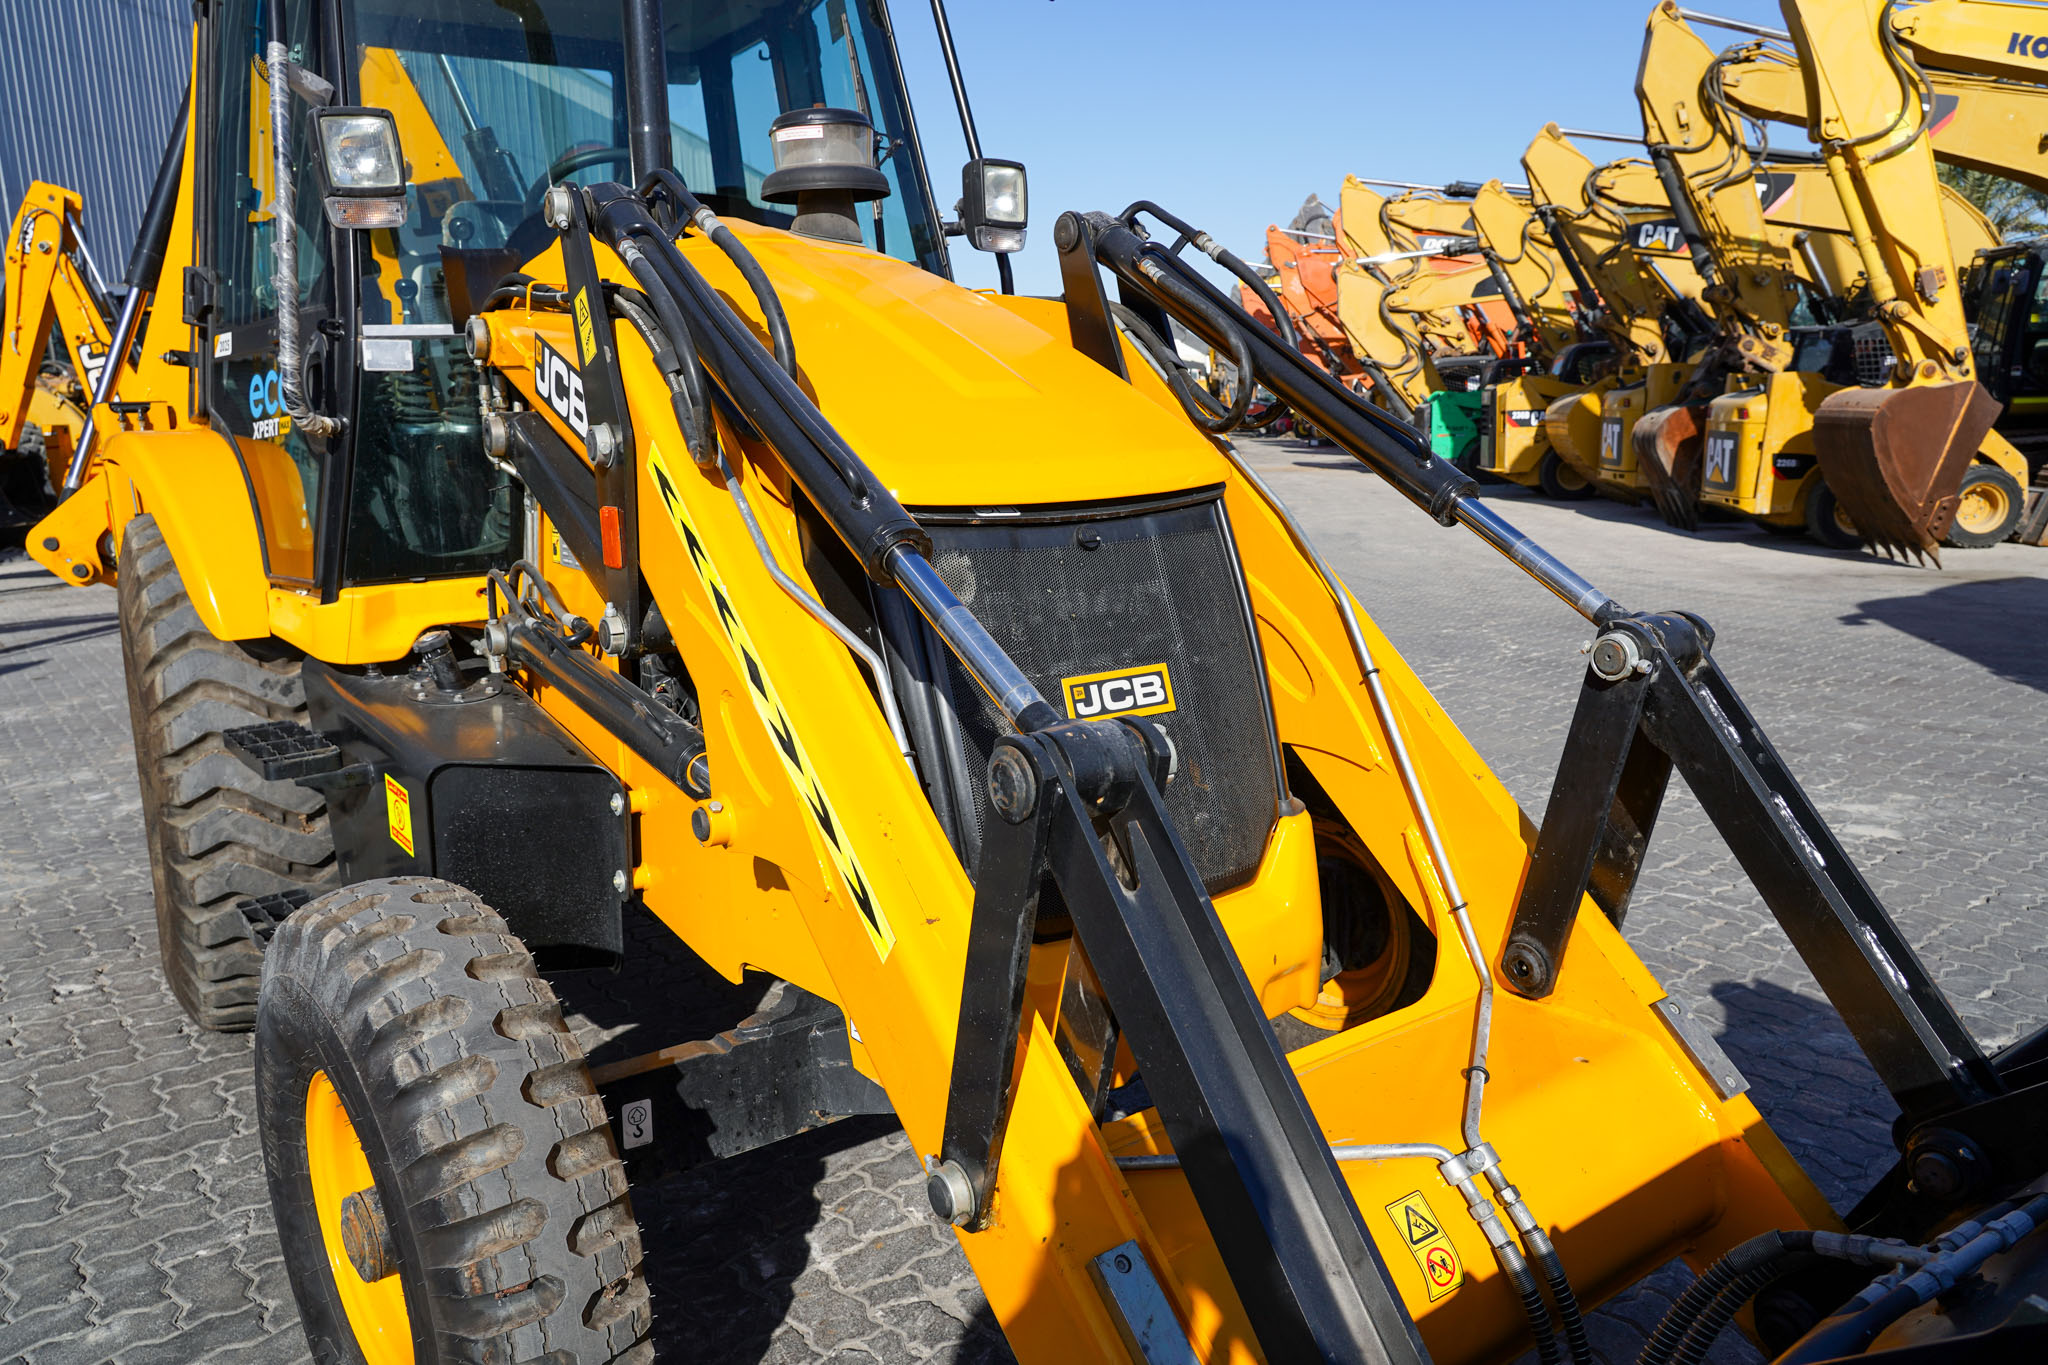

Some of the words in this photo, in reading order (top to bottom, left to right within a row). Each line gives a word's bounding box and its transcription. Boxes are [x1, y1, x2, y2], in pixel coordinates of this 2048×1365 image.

[1638, 223, 1680, 250] CAT
[536, 346, 589, 438] JCB
[252, 417, 280, 441] XPERT
[1601, 421, 1621, 460] CAT
[1705, 437, 1735, 483] CAT
[1076, 674, 1165, 716] JCB
